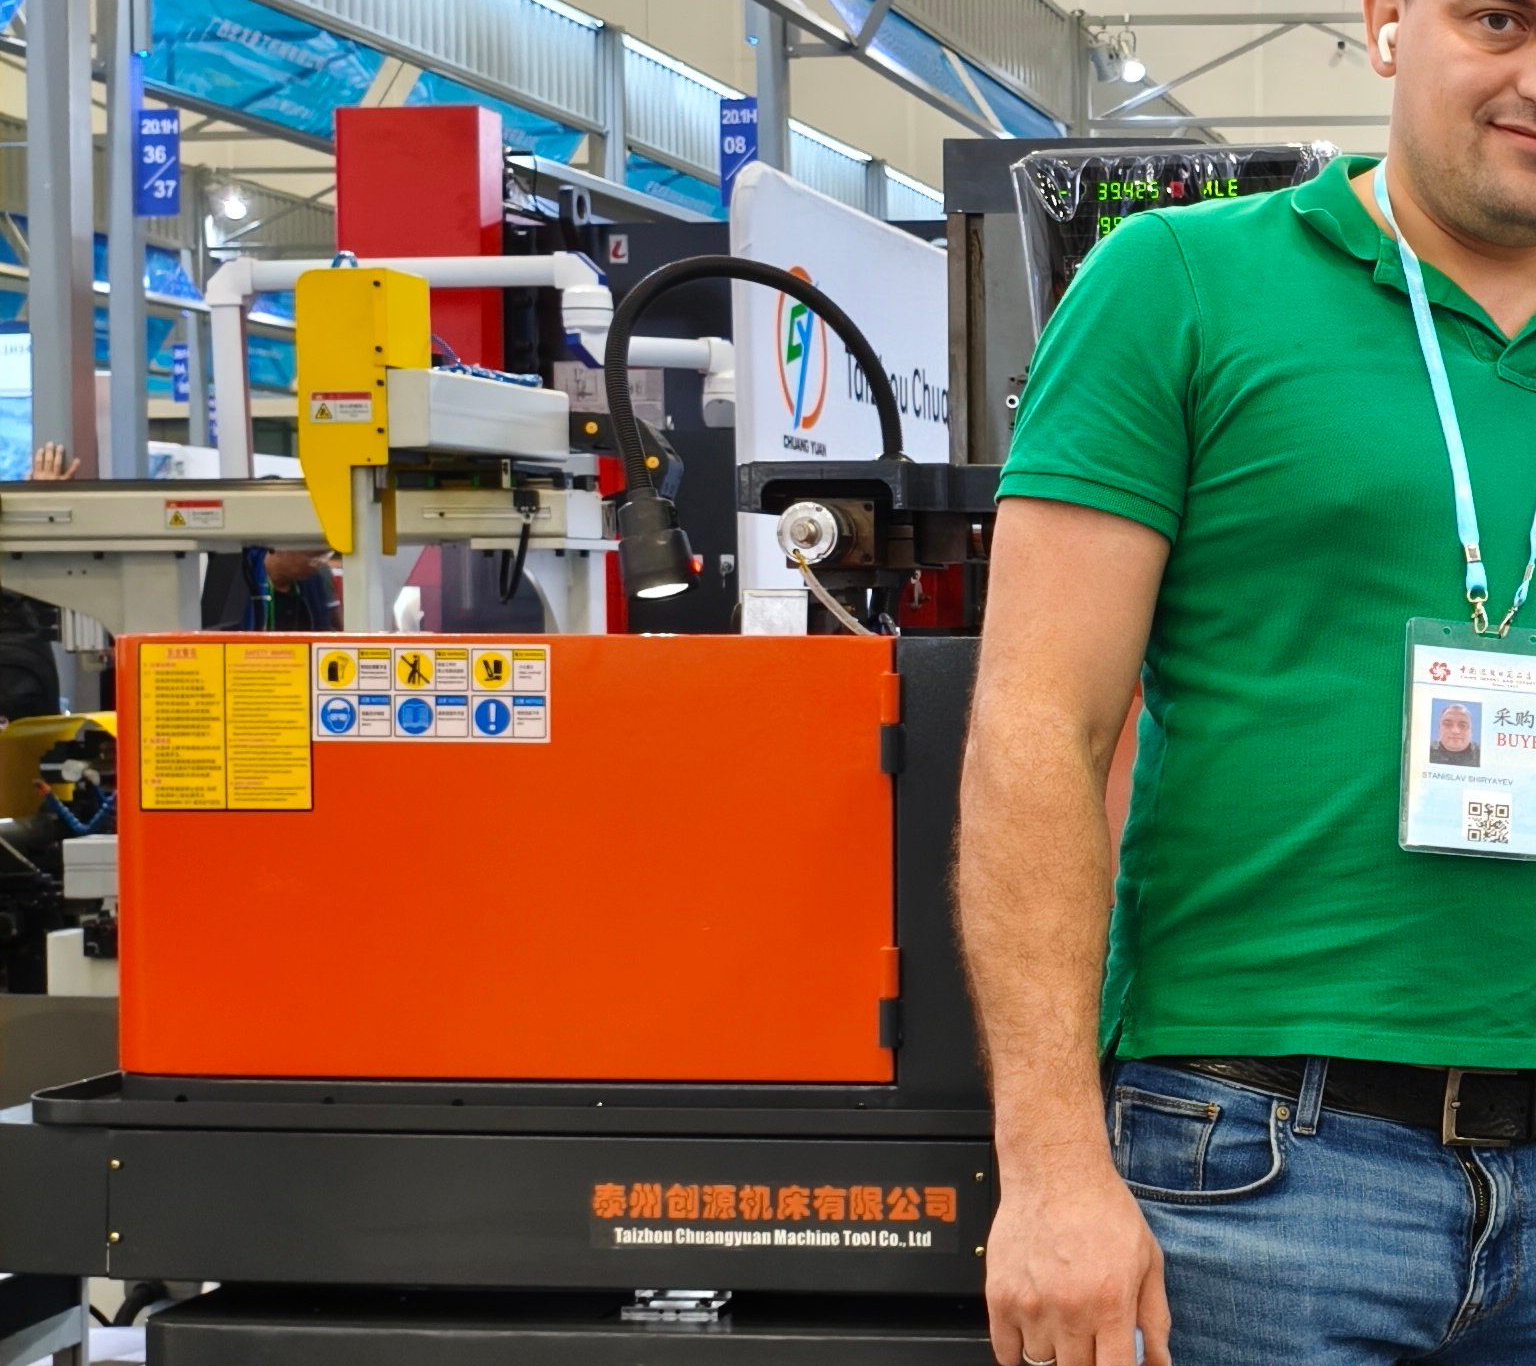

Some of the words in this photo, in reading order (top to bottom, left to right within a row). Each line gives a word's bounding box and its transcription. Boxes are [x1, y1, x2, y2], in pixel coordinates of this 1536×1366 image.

[143, 145, 166, 164] 36
[724, 136, 747, 154] 08
[153, 180, 177, 198] 37
[783, 435, 809, 452] CHUANG
[811, 443, 827, 457] YUAN
[592, 1183, 958, 1223] 泰州创源机床有限公司
[614, 1227, 673, 1244] Taizhou
[676, 1228, 771, 1248] Chuangyuan
[774, 1229, 840, 1247] Machine
[843, 1230, 877, 1247] Tool
[879, 1231, 906, 1248] Co.,
[909, 1231, 932, 1248] Ltd
